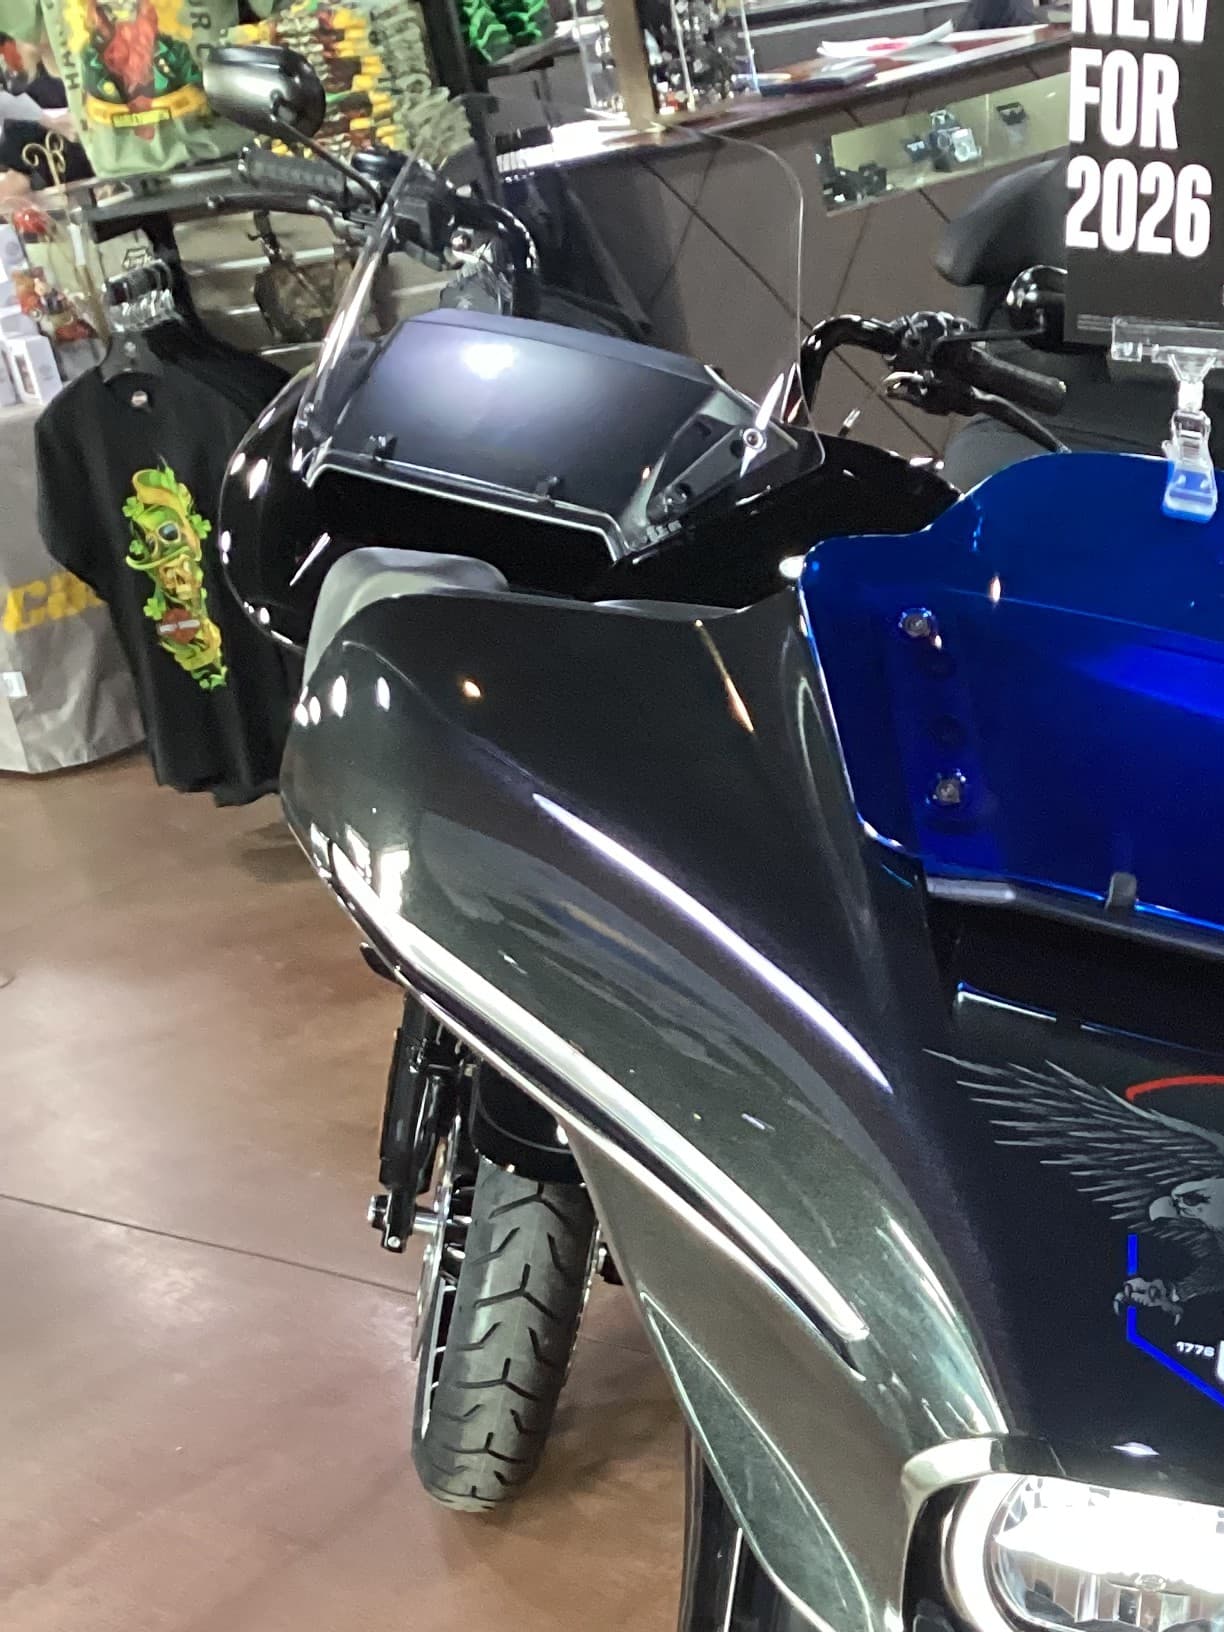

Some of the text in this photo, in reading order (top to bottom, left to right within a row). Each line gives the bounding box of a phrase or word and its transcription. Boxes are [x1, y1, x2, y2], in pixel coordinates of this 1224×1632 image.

[1068, 47, 1180, 150] FOR
[1065, 155, 1213, 259] 2026
[1176, 1341, 1215, 1357] 1776
